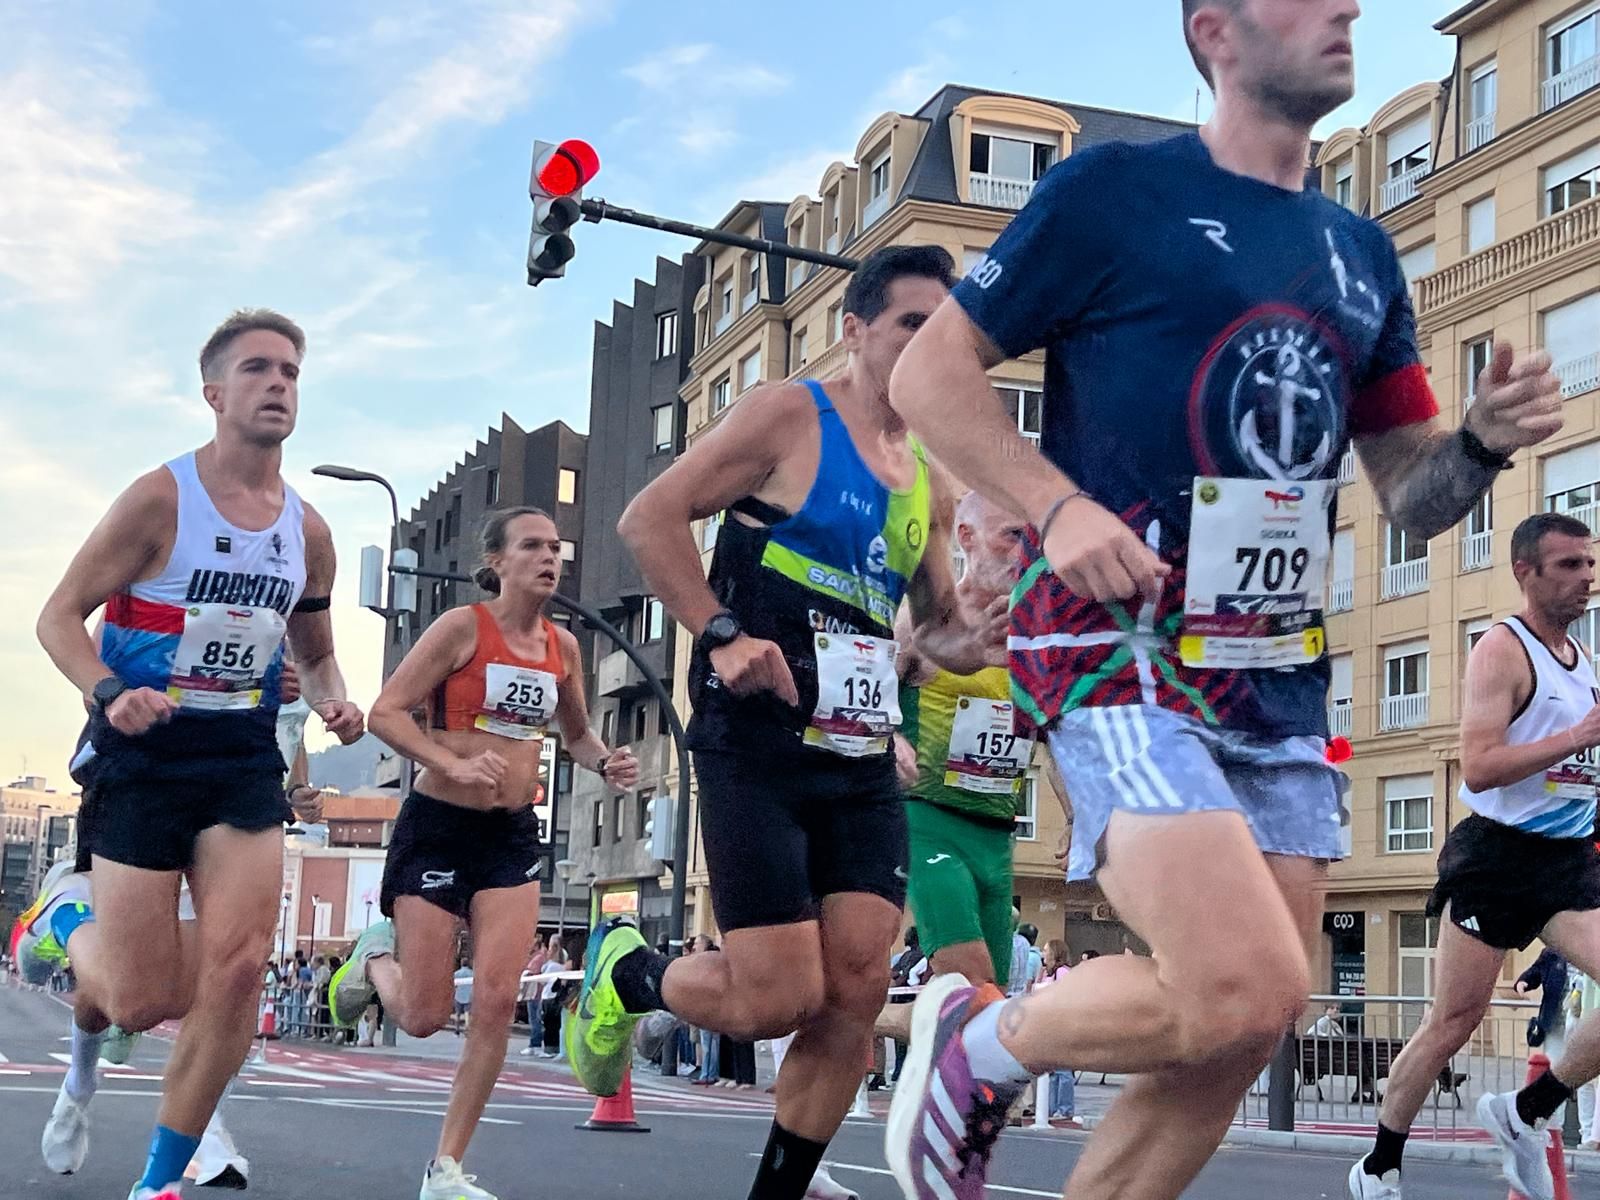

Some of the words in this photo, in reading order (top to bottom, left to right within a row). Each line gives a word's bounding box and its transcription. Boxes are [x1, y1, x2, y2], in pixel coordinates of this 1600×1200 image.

[1236, 547, 1309, 592] 709
[202, 640, 257, 669] 856
[505, 681, 544, 707] 253
[844, 676, 882, 709] 136
[976, 731, 1017, 757] 157
